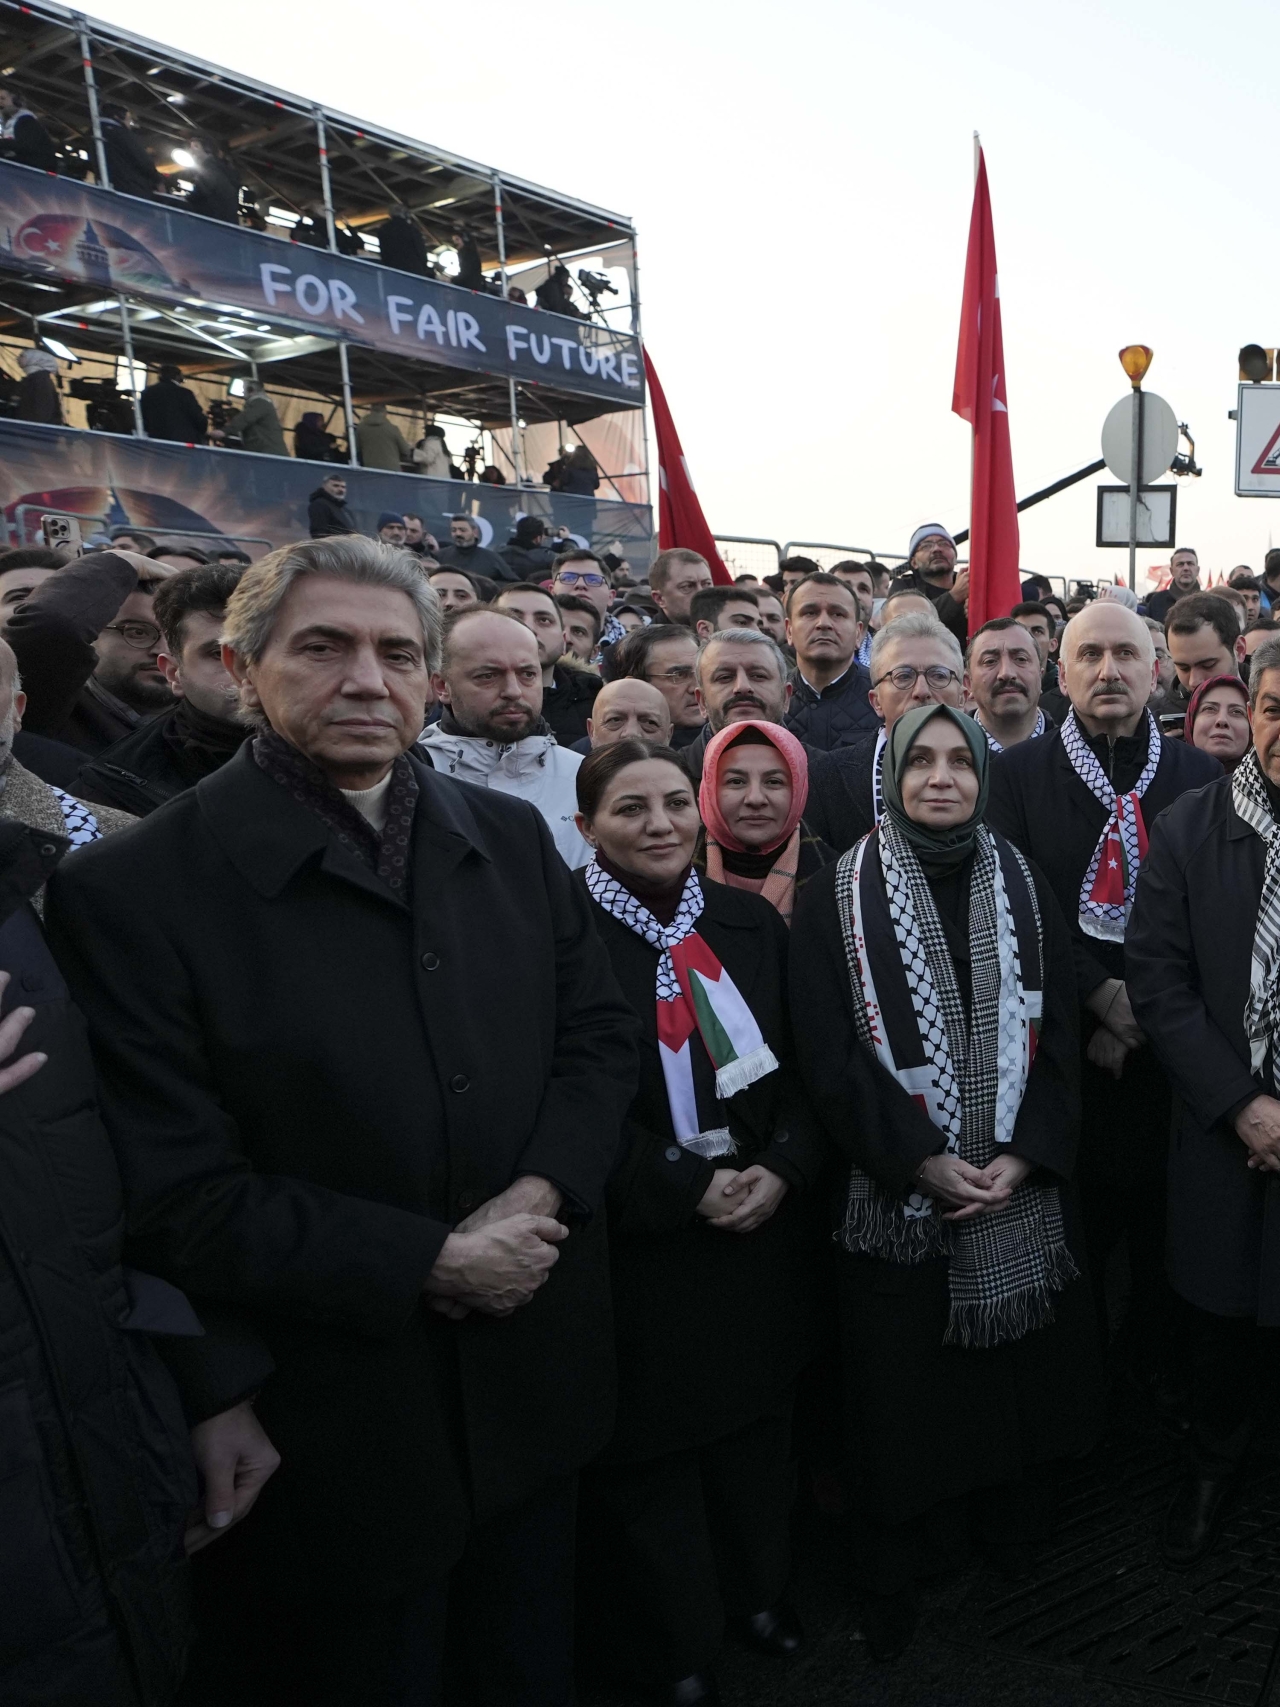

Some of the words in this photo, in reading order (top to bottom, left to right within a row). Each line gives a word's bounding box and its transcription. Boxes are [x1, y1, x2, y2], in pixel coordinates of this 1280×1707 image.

[260, 263, 365, 324] FOR
[387, 295, 486, 352] FAIR
[506, 325, 640, 387] FUTURE
